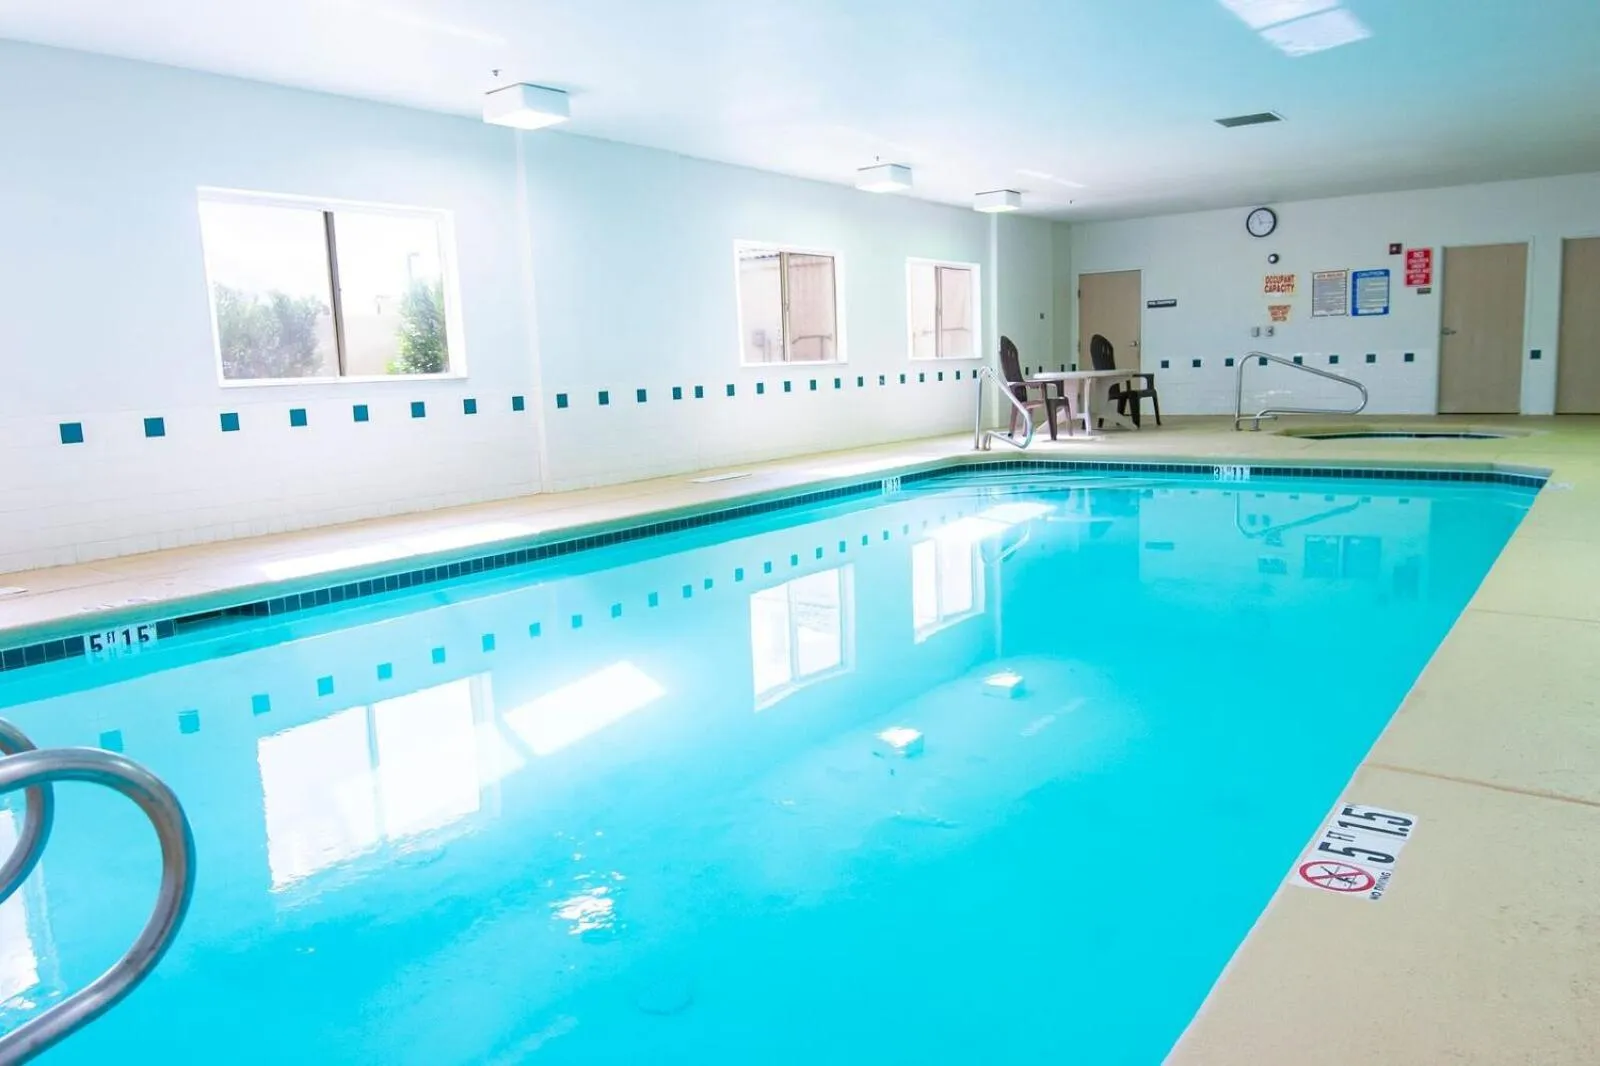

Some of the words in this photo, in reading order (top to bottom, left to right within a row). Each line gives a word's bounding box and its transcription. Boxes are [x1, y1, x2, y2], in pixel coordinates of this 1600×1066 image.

[1264, 274, 1295, 284] OCCUPANT
[1264, 284, 1295, 293] CAPACITY
[89, 633, 104, 653] 5
[1326, 830, 1356, 842] FT
[1318, 841, 1395, 864] 5
